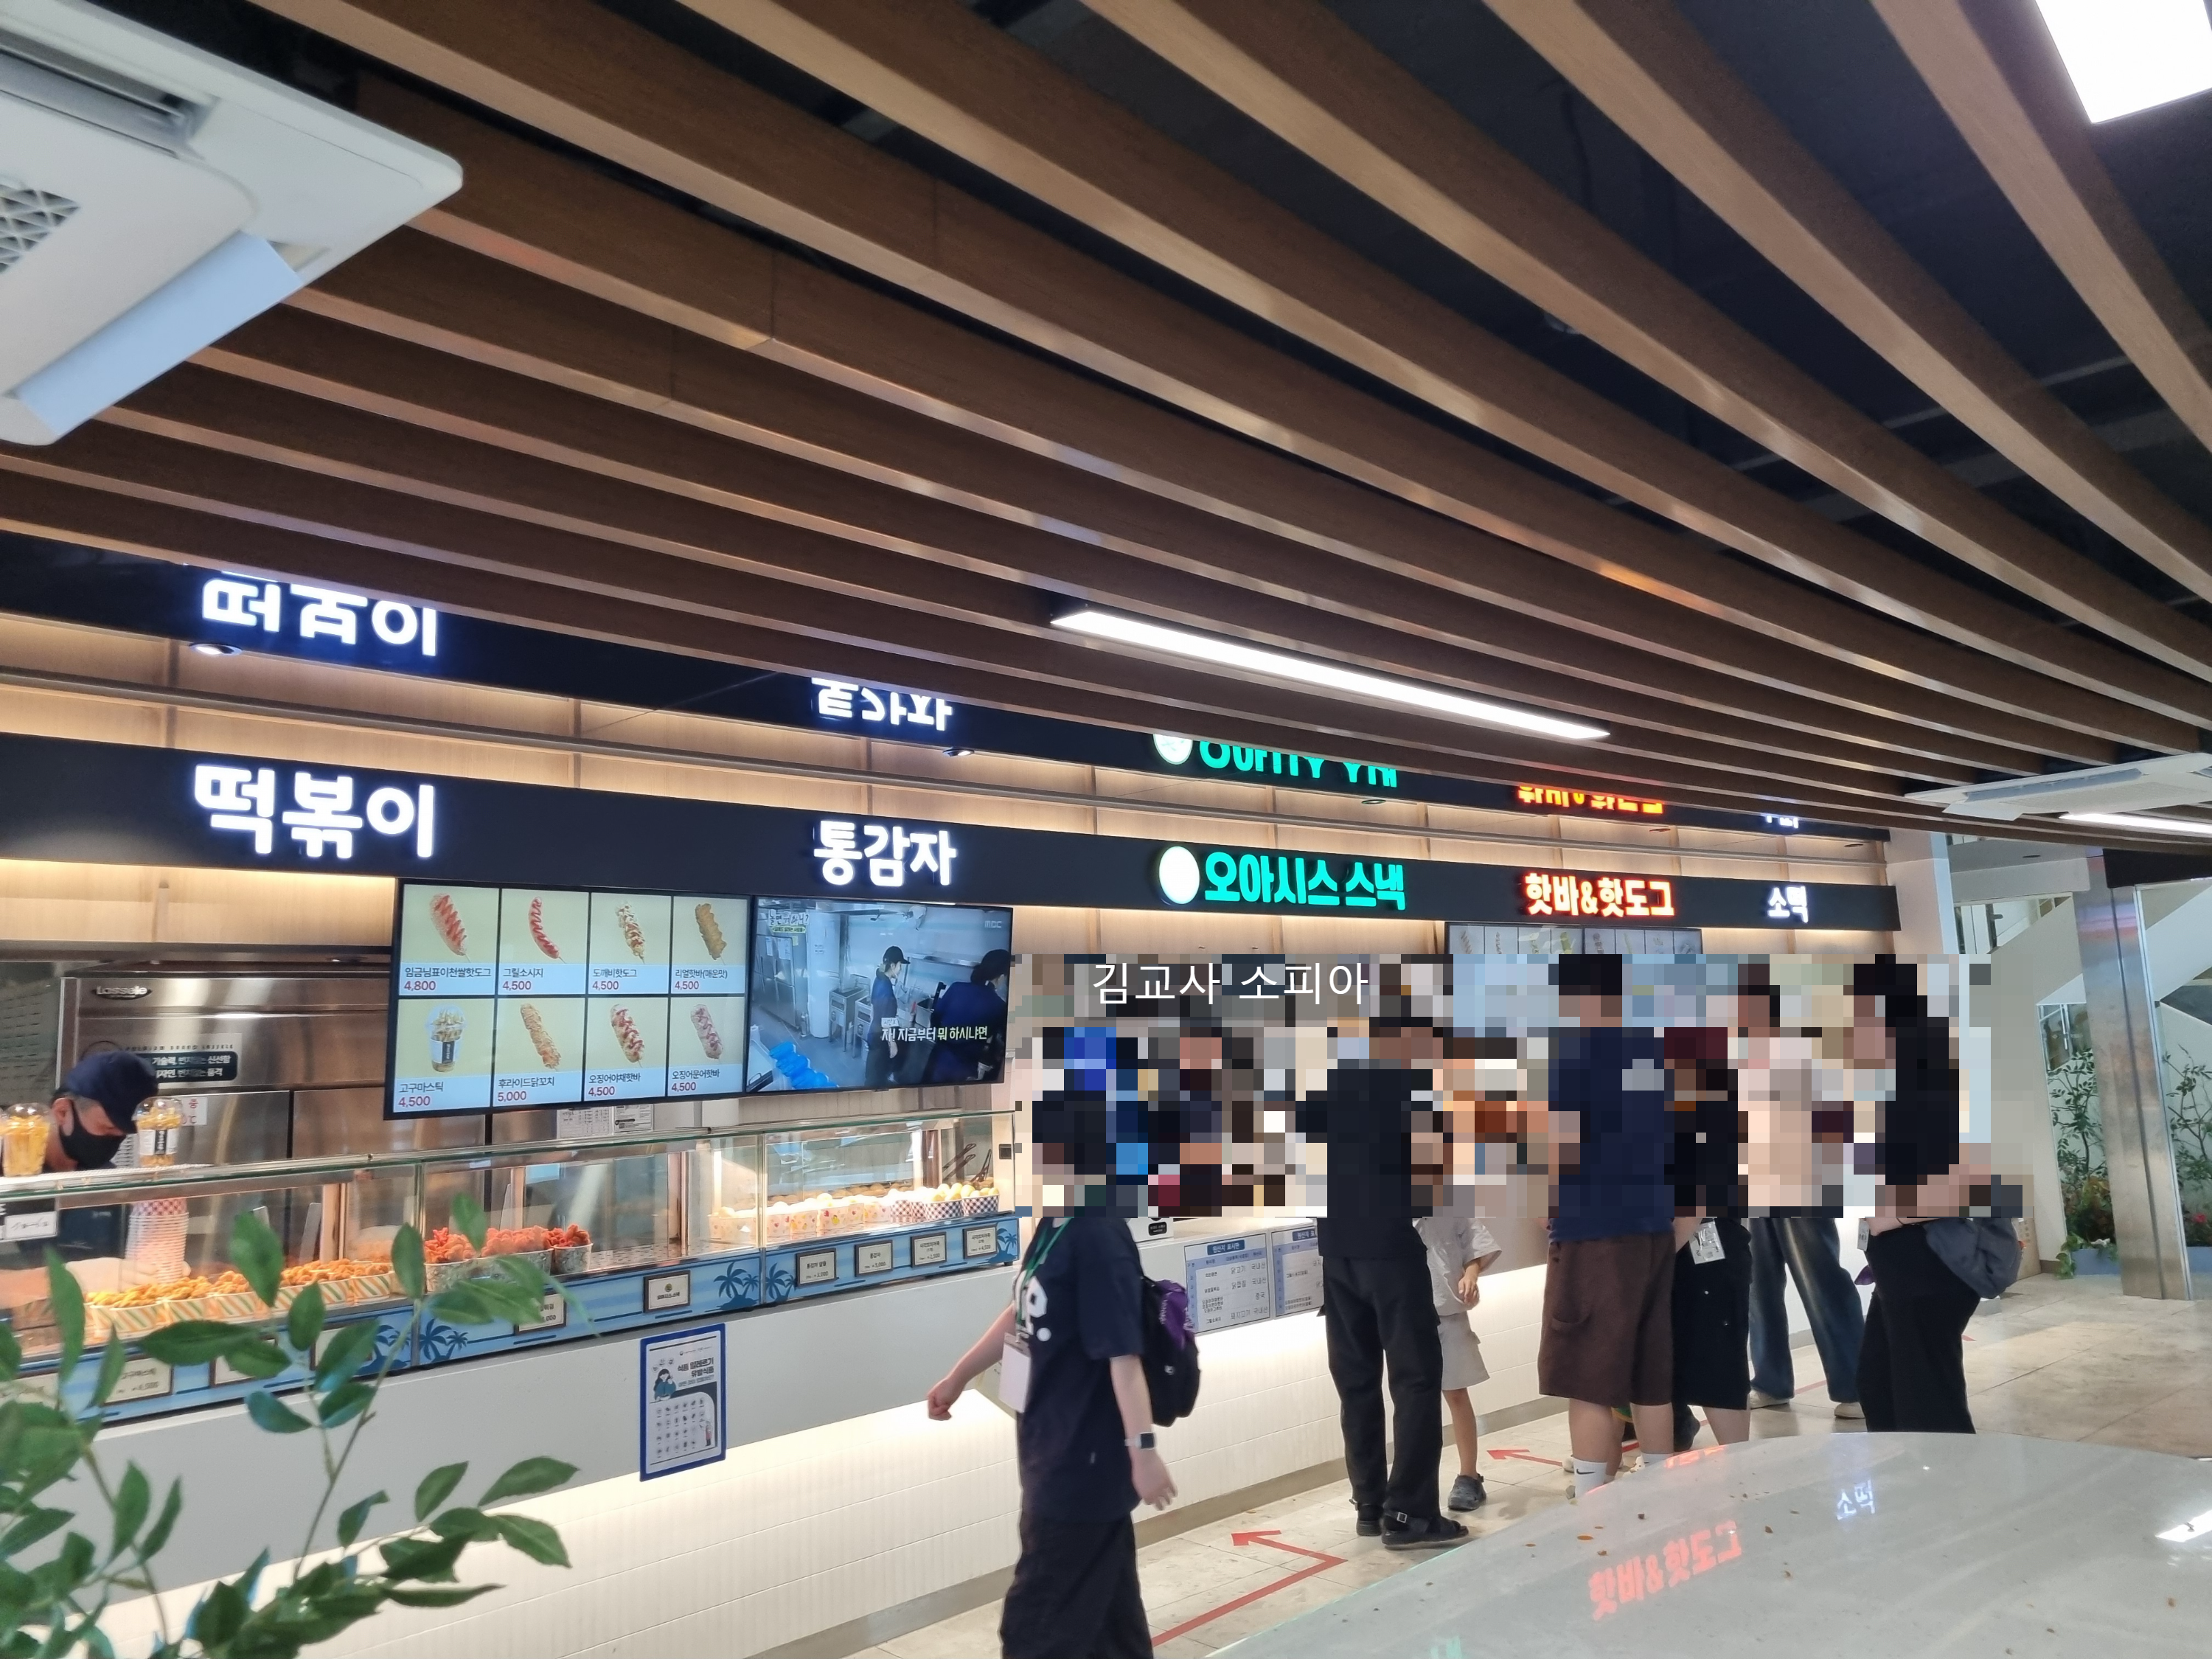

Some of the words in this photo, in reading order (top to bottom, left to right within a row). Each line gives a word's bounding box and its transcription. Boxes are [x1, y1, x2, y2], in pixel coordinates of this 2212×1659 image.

[193, 765, 435, 859] 떡볶이
[813, 820, 956, 886] 통감자
[1205, 852, 1340, 906] 오아시스
[1346, 862, 1406, 910] 스낵
[1523, 872, 1675, 918] 핫바&핫도그
[1767, 886, 1809, 923] 소떡
[405, 967, 492, 978] 임금님표이천쌀핫도그
[502, 967, 544, 978] 그릴소시지
[592, 968, 638, 978] 도깨비핫도그
[675, 969, 728, 980] 리얼핫바(매운맛)
[404, 980, 437, 992] 4,800
[502, 980, 532, 991] 4,500
[592, 980, 619, 991] 4,500
[674, 980, 700, 991] 4,500
[881, 1029, 896, 1042] 자!
[897, 1026, 936, 1042] 지금부터
[937, 1027, 947, 1041] 뭐
[949, 1026, 988, 1040] 하시냐면
[588, 1072, 641, 1084] 오징어야채핫바
[672, 1069, 720, 1080] 오징어문어핫바
[399, 1082, 444, 1093] 고구마스틱
[498, 1077, 555, 1089] 후라이드닭꼬치
[671, 1082, 697, 1092] 4,500
[497, 1091, 526, 1102] 5,000
[588, 1086, 616, 1097] 4,500
[398, 1096, 431, 1107] 4,500
